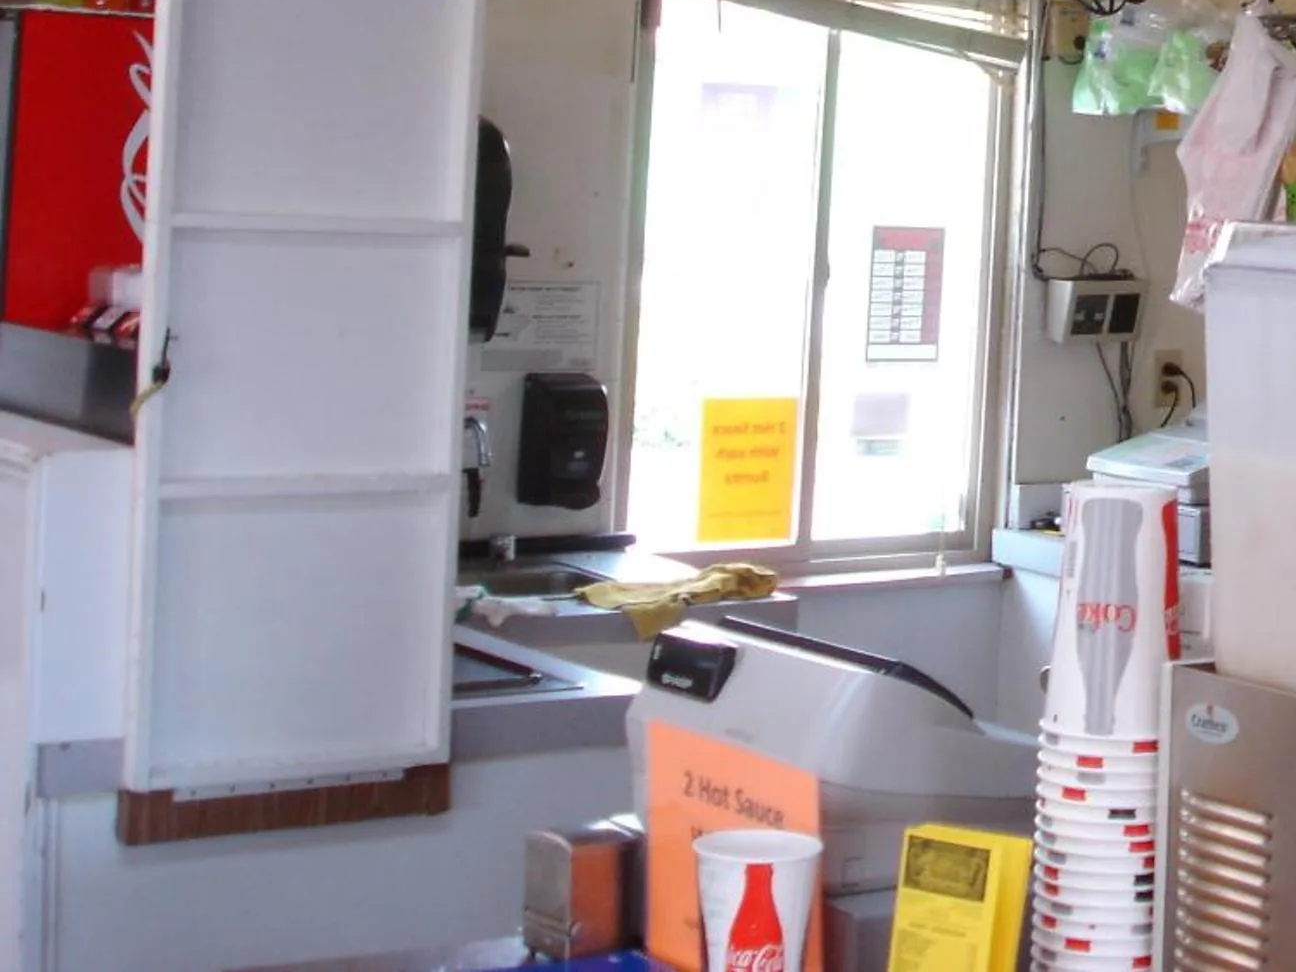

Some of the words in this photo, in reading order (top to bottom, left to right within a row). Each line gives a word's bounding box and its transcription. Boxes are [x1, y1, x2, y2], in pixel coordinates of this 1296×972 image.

[683, 769, 694, 798] 2
[698, 772, 730, 810] Hot
[735, 787, 785, 829] Sauce
